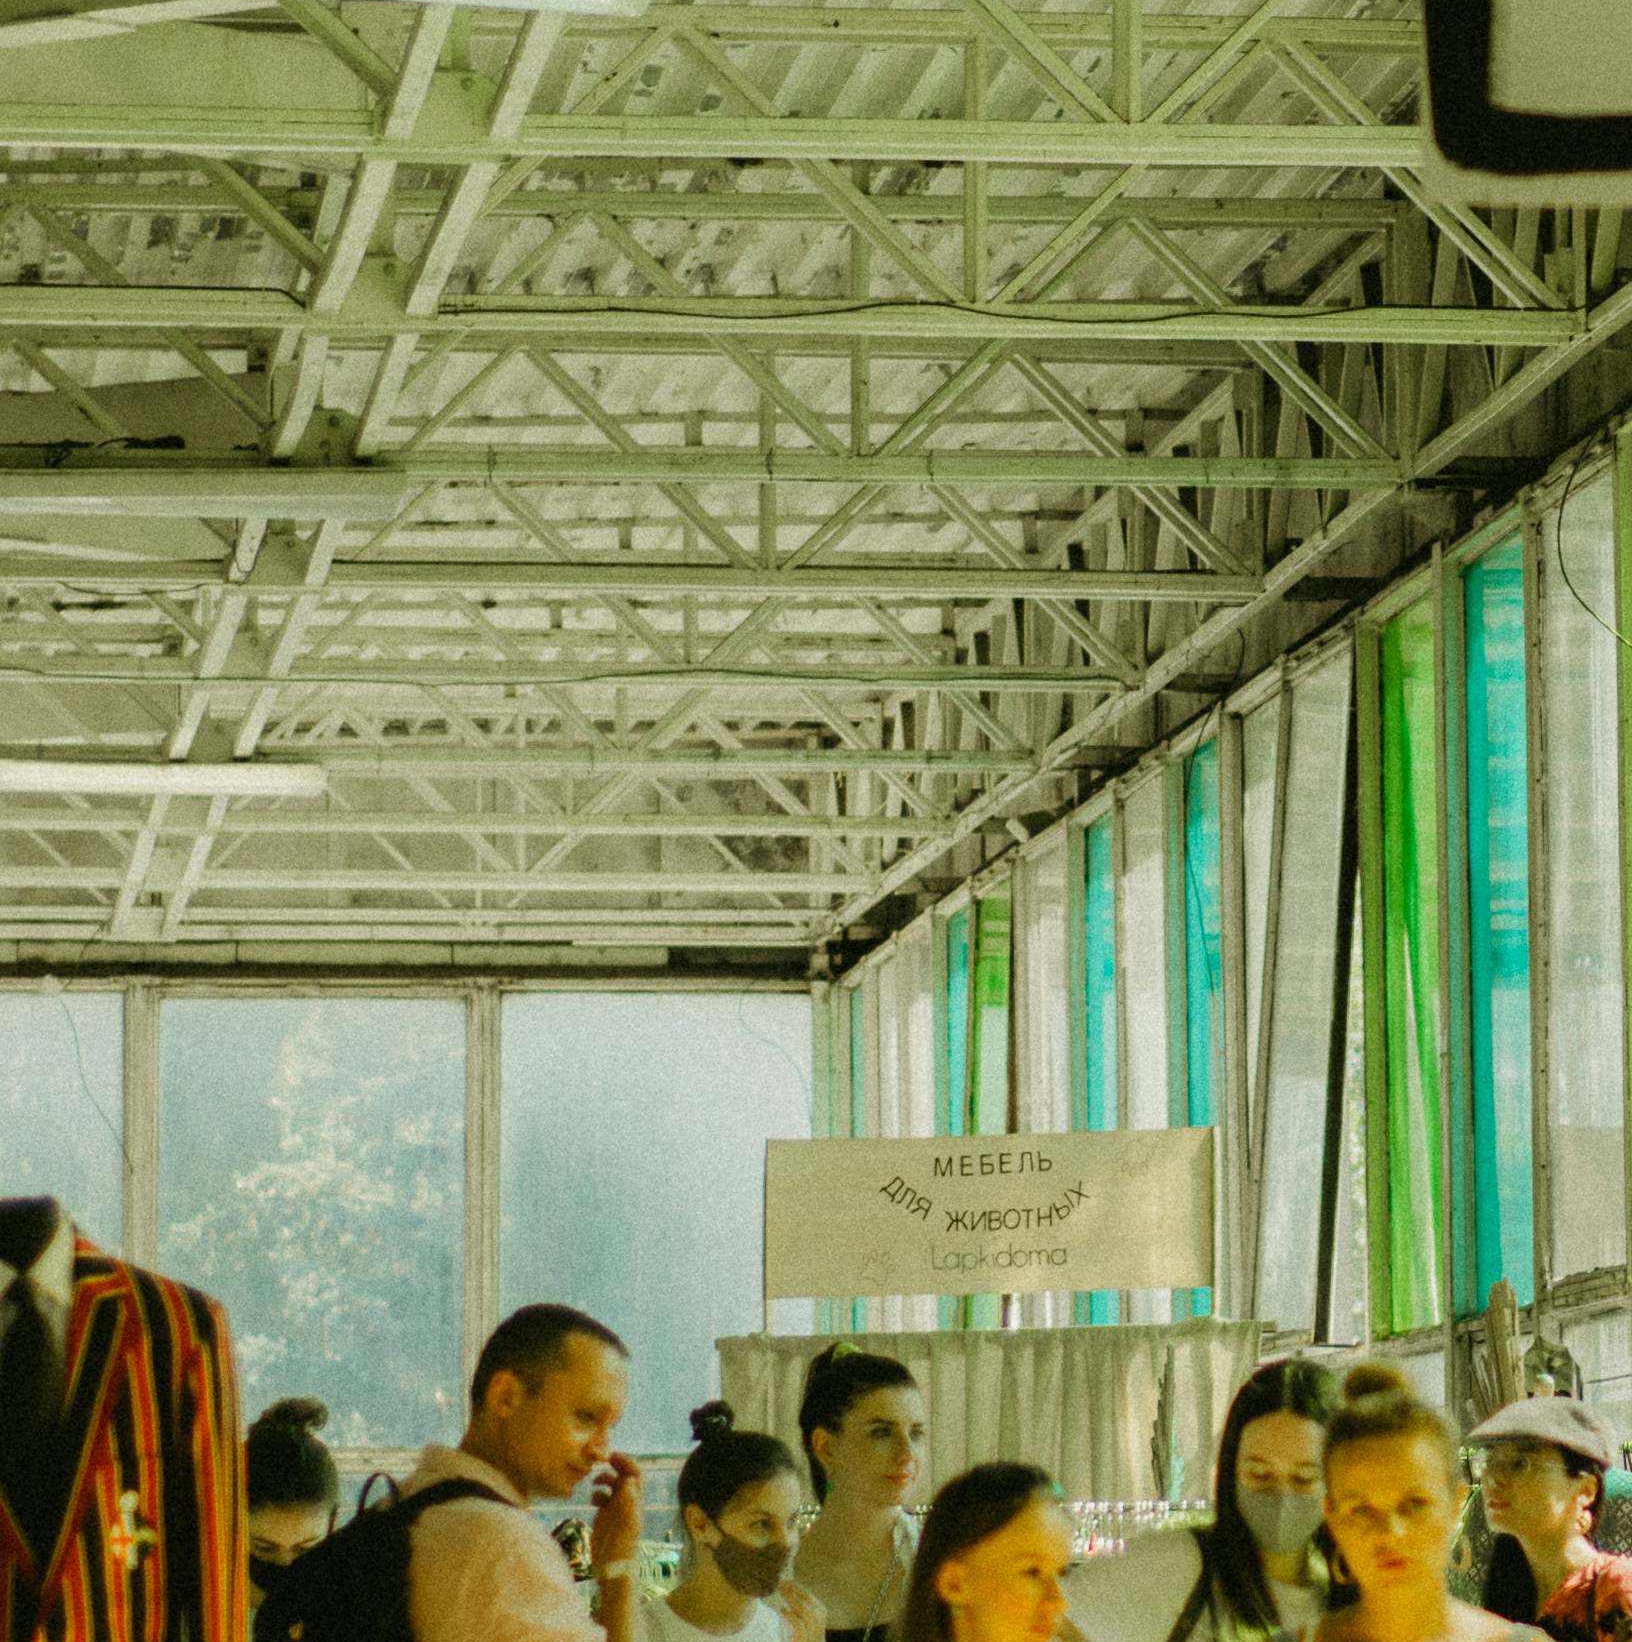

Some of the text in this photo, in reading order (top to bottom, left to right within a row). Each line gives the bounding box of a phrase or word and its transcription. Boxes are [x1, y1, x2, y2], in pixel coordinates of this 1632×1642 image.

[934, 1151, 1053, 1178] МЕБЕЛЬ
[879, 1175, 1090, 1233] ДЛЯ ЖИВОТНЫХ
